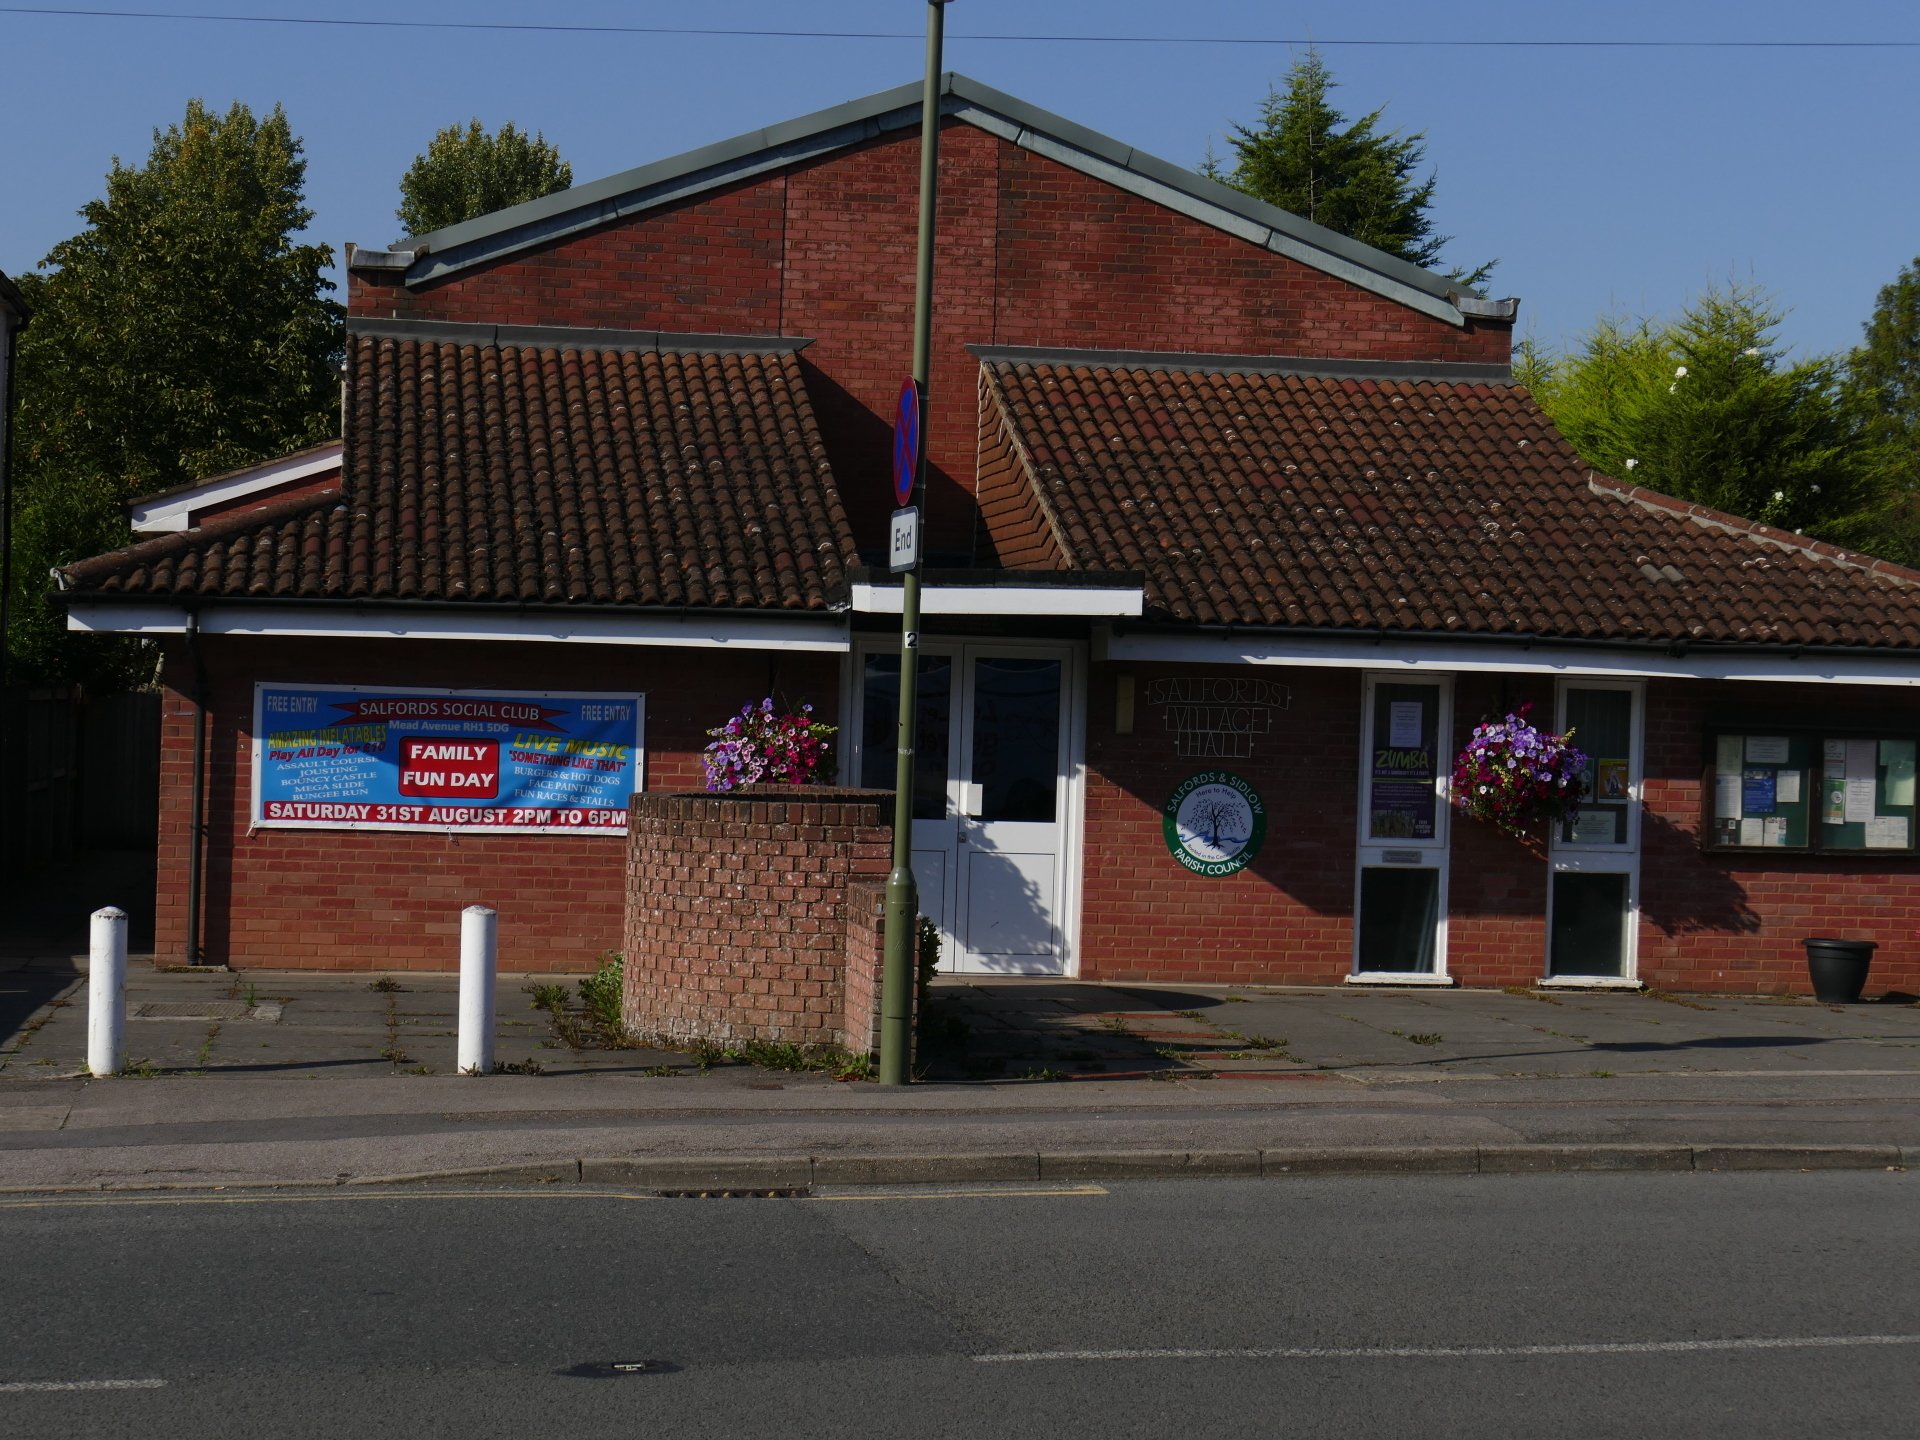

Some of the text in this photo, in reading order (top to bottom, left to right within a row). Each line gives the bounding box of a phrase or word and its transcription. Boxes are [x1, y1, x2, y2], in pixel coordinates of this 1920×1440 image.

[895, 525, 912, 552] End
[907, 632, 917, 647] 2
[1151, 677, 1281, 706] SALFORDS
[267, 696, 318, 713] FREE ENTRY
[360, 702, 539, 721] SALFORDS SOCIAL CLUB
[581, 705, 631, 721] FREE ENTRY
[389, 720, 509, 733] Mead Avenue RH1 5DG
[1174, 706, 1260, 733] VILLAGE
[268, 725, 387, 749] AMAZING INFLATABLES
[1188, 731, 1249, 757] HALL
[269, 750, 294, 762] Play
[296, 747, 314, 758] All
[317, 747, 340, 758] Day
[343, 744, 361, 754] for
[411, 745, 488, 761] FAMILY
[513, 733, 629, 760] LIVE MUSIC
[277, 757, 379, 771] ASSAULT COURSE
[571, 757, 595, 769] LIKE
[1375, 749, 1430, 769] ZUMBA
[281, 772, 377, 786] BOUNCY CASTLE
[300, 766, 358, 777] JOUSTING
[403, 772, 495, 788] FUN DAY
[514, 766, 559, 779] BURGERS
[570, 772, 593, 782] HOT
[594, 775, 620, 785] DOGS
[292, 788, 368, 801] BUNGEE RUN
[294, 781, 365, 793] MEGA SLIDE
[529, 779, 603, 794] FACE PAINTING
[1167, 772, 1263, 814] SALFORDS & SIDLOW
[1196, 788, 1212, 798] Here
[1222, 788, 1236, 799] Help
[515, 789, 615, 807] FUN RACES & STALLS
[269, 803, 627, 825] SATURDAY 31ST AUGUST 2PM TO 6PM
[1174, 848, 1254, 875] PARISH COUNCIL
